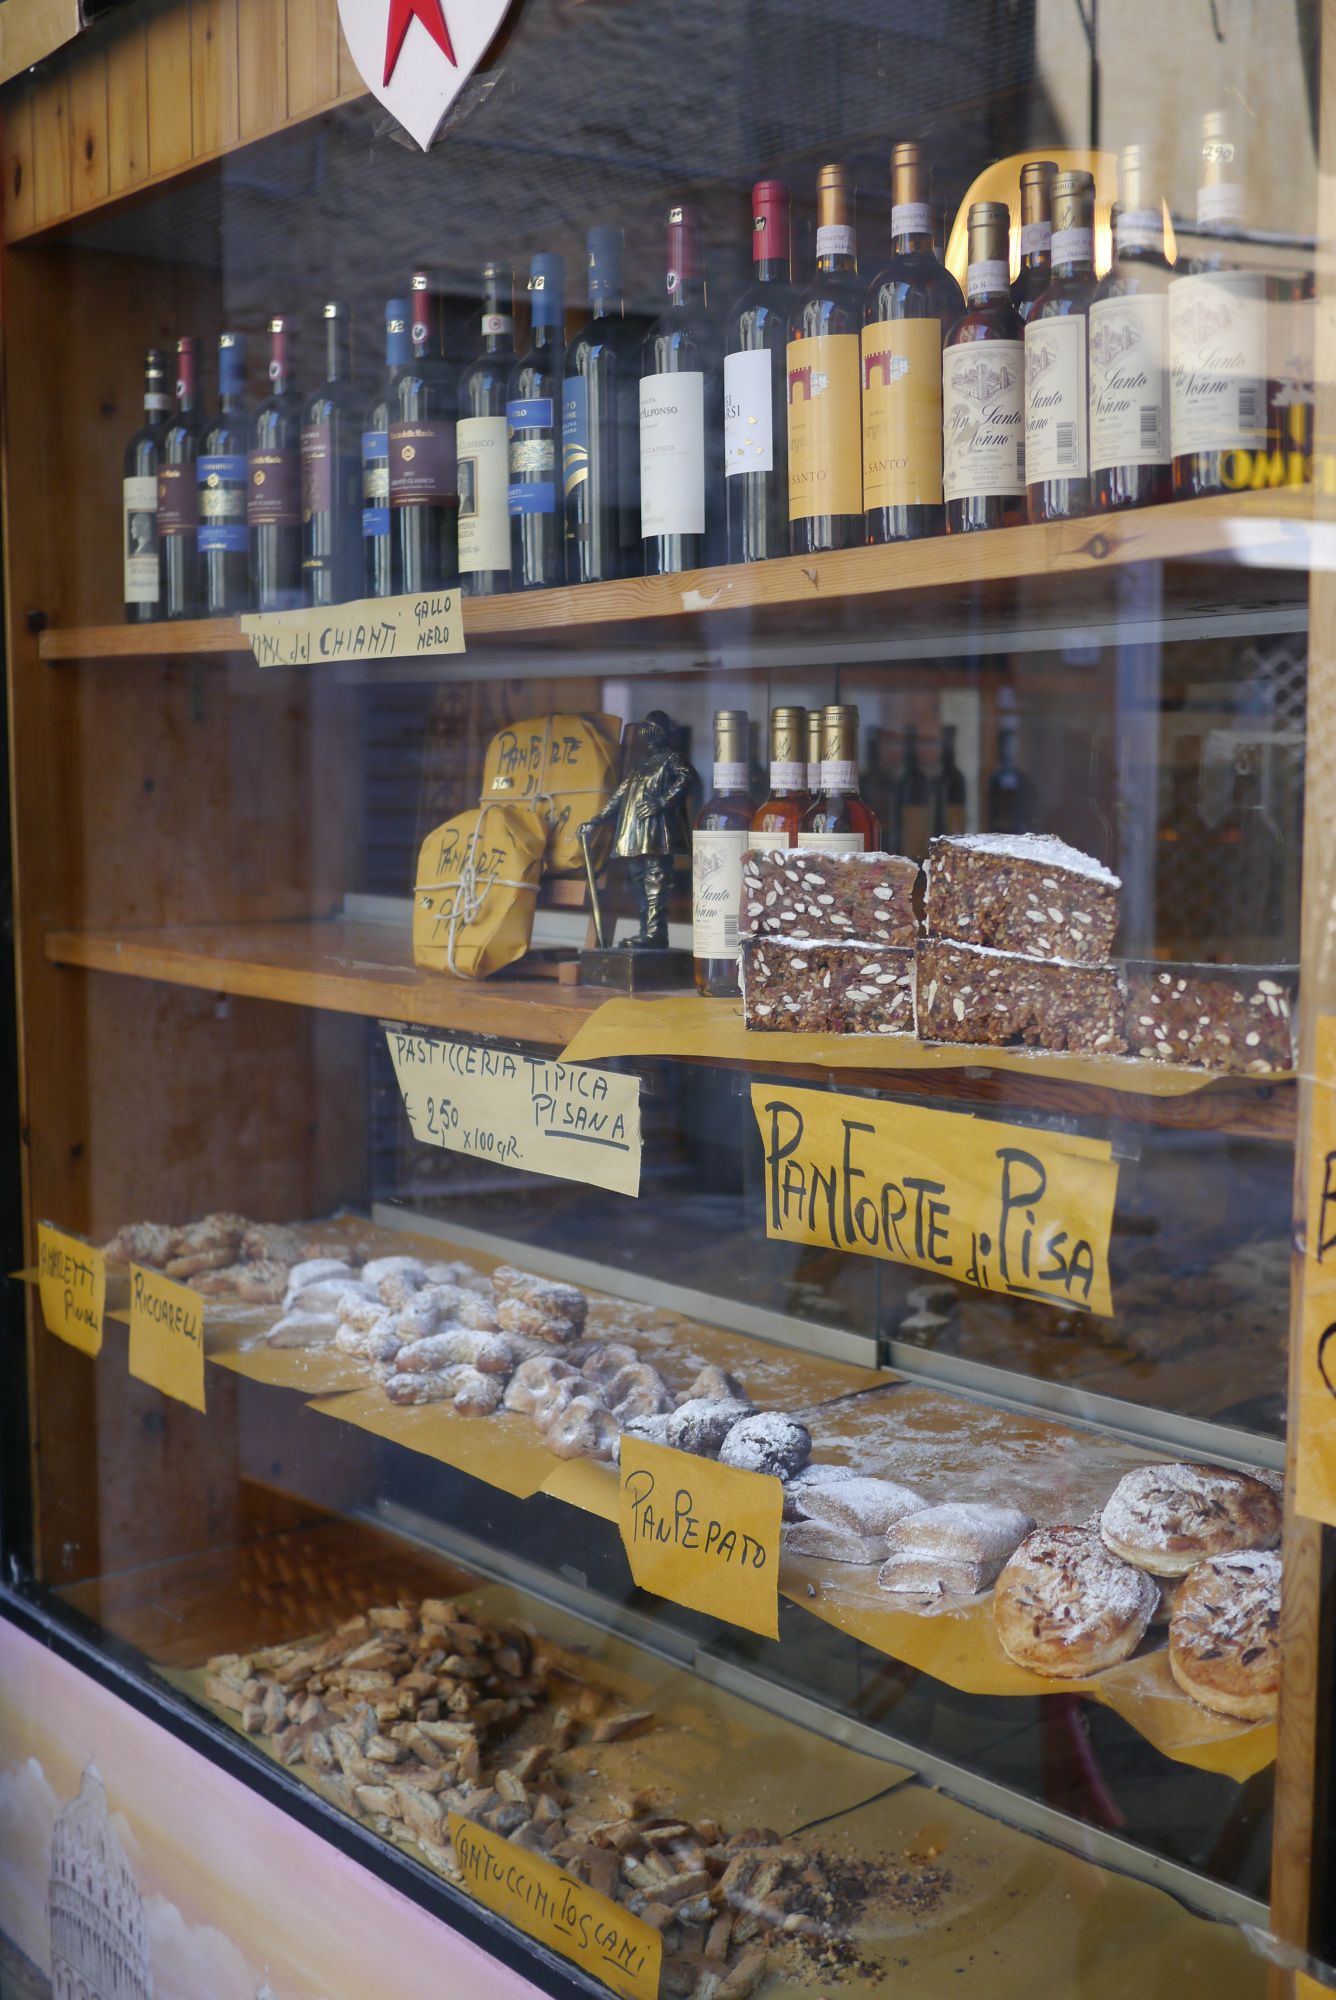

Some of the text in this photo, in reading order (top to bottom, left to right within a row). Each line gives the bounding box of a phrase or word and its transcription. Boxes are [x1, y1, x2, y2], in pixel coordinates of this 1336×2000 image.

[1104, 367, 1150, 392] Santo
[1028, 386, 1064, 411] Santo
[981, 403, 1023, 426] Santo
[791, 470, 827, 486] SANTO
[867, 457, 907, 474] SANTO
[414, 596, 452, 627] GALLO
[319, 620, 398, 657] CHIANTI
[416, 626, 450, 651] NERO
[698, 883, 731, 901] Santo
[395, 1034, 609, 1101] PASTICCERIA TIPICA
[531, 1093, 625, 1140] PISANA
